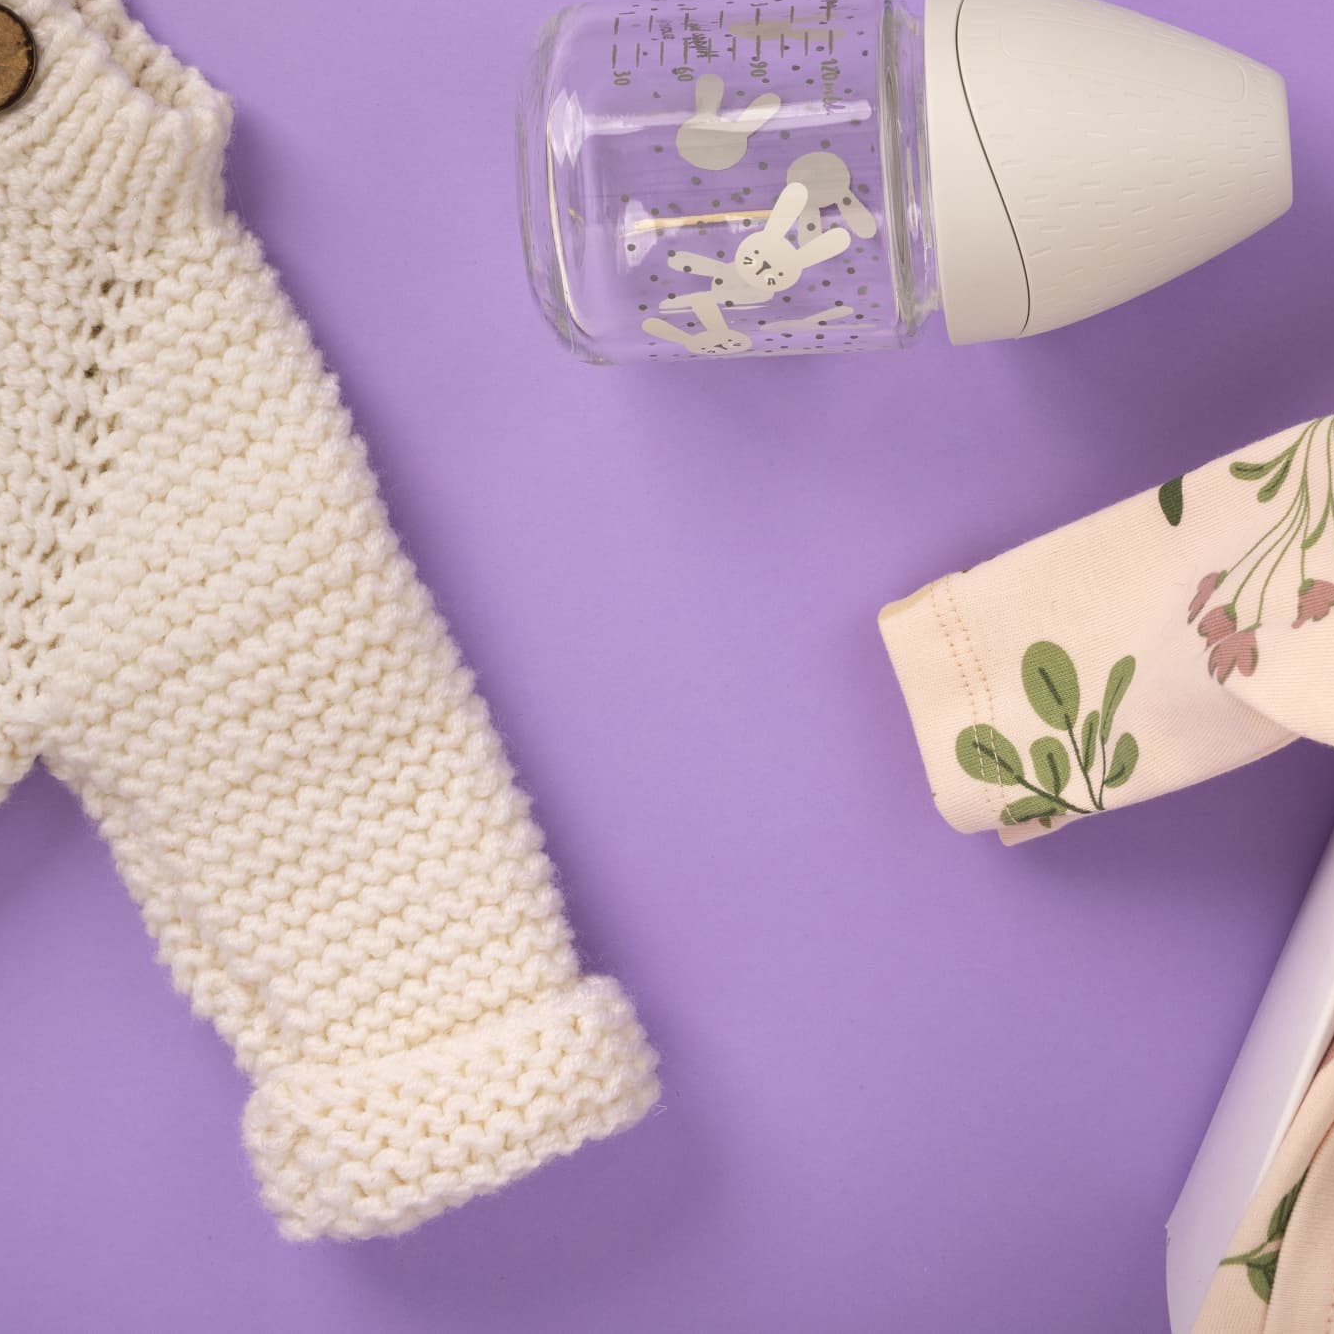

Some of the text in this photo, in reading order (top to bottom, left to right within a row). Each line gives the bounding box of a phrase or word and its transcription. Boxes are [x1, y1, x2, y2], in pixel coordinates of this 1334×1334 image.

[676, 66, 695, 82] 60
[749, 61, 768, 77] 90
[612, 70, 632, 86] 30
